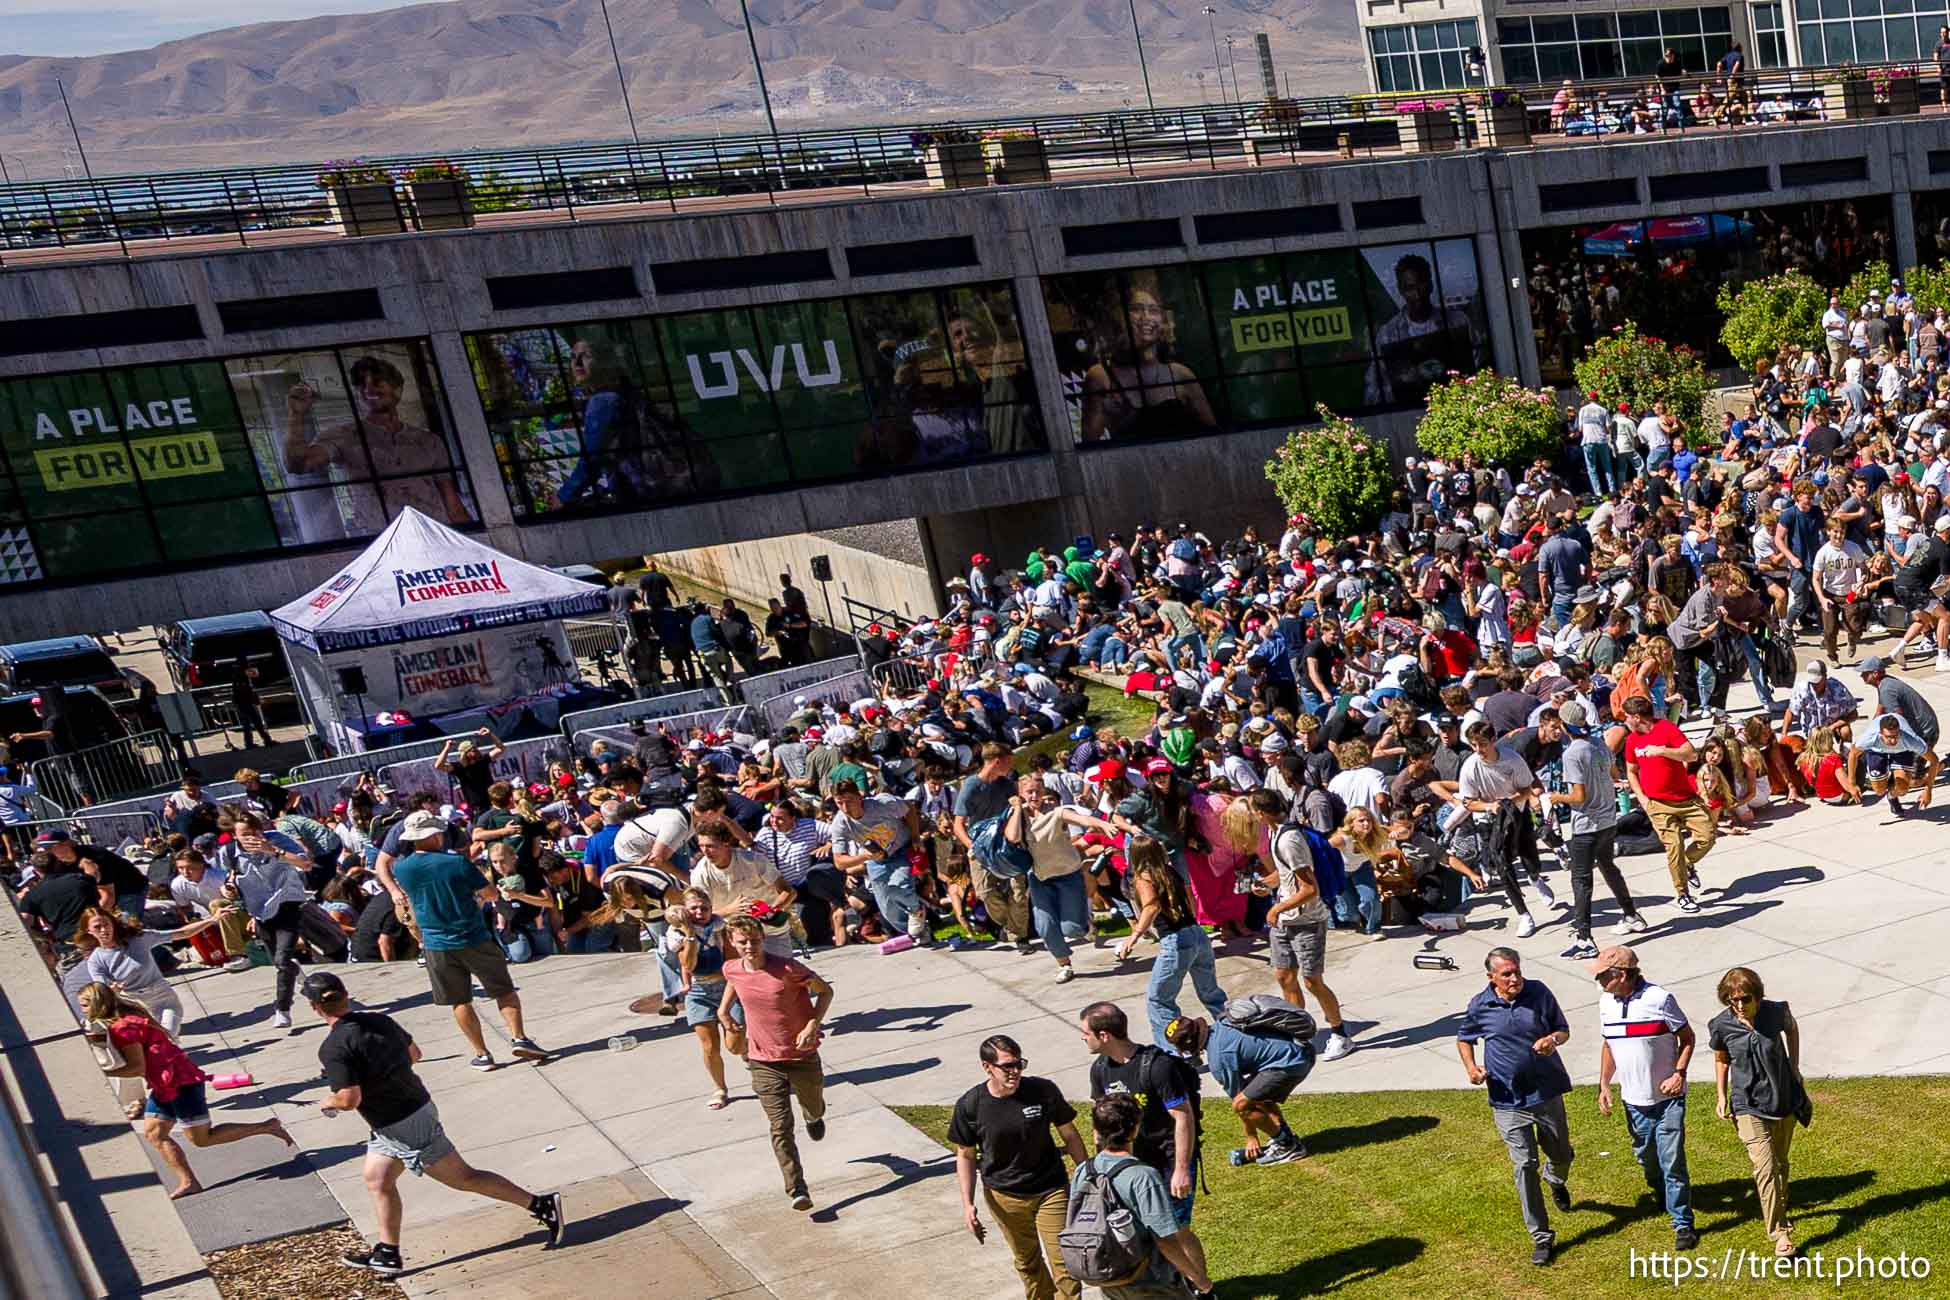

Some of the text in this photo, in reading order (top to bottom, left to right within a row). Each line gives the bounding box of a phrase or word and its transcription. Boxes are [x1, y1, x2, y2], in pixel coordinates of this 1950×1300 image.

[1232, 277, 1338, 310] A PLACE
[1240, 313, 1344, 345] FOR YOU
[686, 339, 842, 400] UVU
[35, 396, 198, 440] A PLACE
[50, 439, 211, 483] FOR YOU
[406, 560, 512, 602] COMEBACK
[475, 594, 604, 628] PROVE ME WRONG
[322, 626, 378, 650] PROVE
[379, 625, 402, 643] ME
[403, 617, 461, 640] WRONG
[403, 638, 492, 697] COMEBACK
